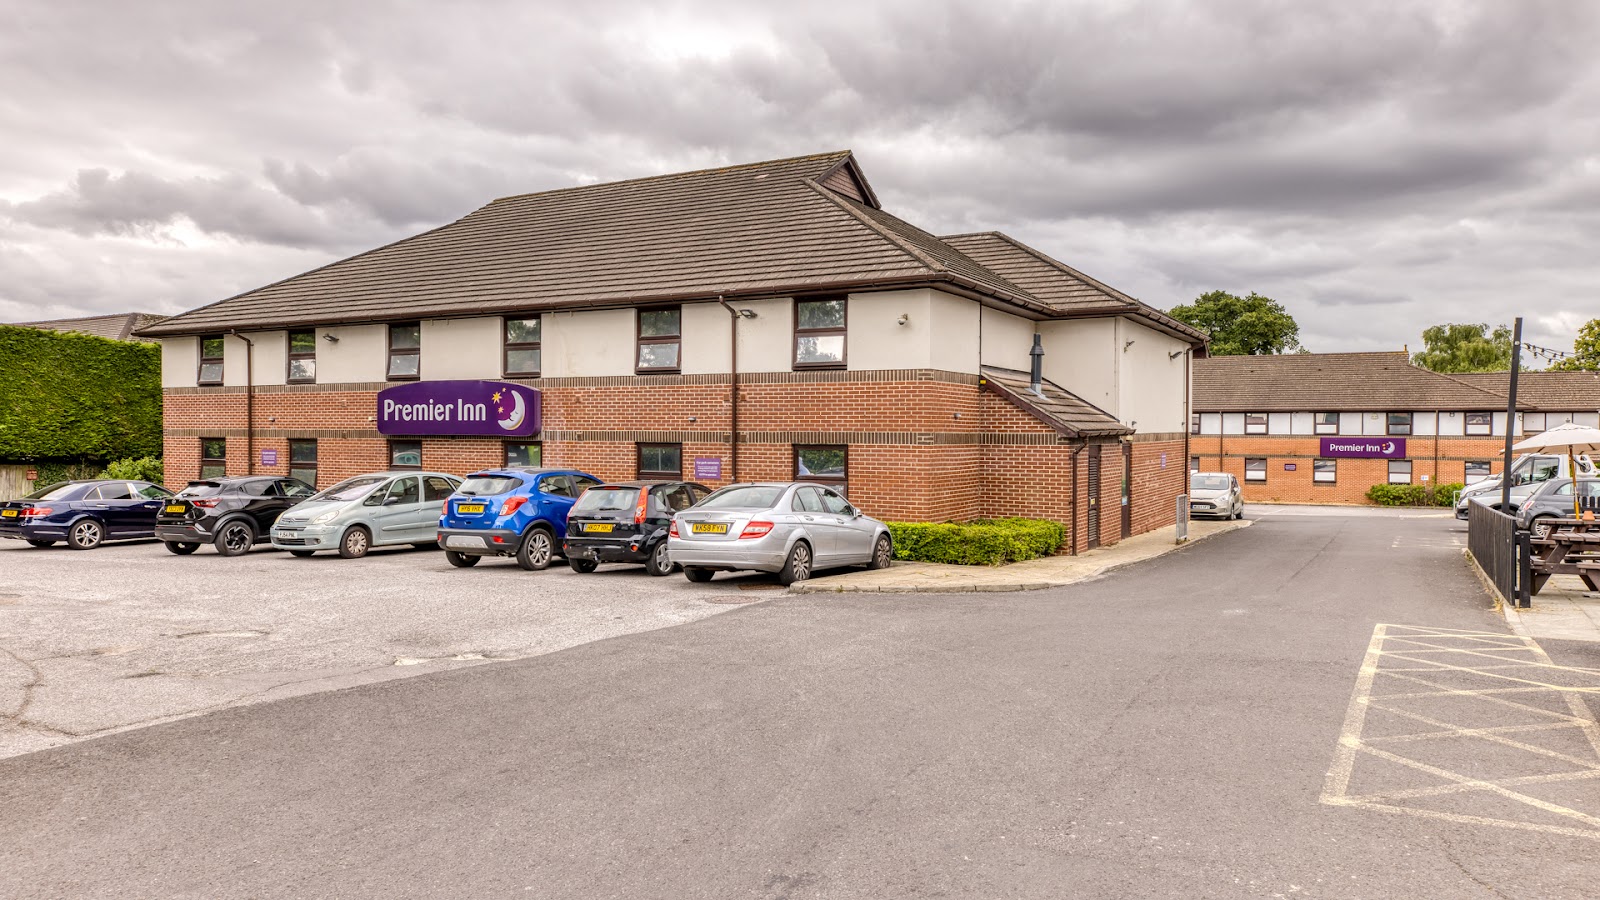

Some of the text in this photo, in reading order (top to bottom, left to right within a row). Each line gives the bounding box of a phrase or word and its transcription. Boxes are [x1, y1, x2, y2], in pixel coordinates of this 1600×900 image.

[383, 398, 487, 422] Premier Inn
[1329, 443, 1380, 452] Premier Inn
[711, 524, 725, 532] FYN
